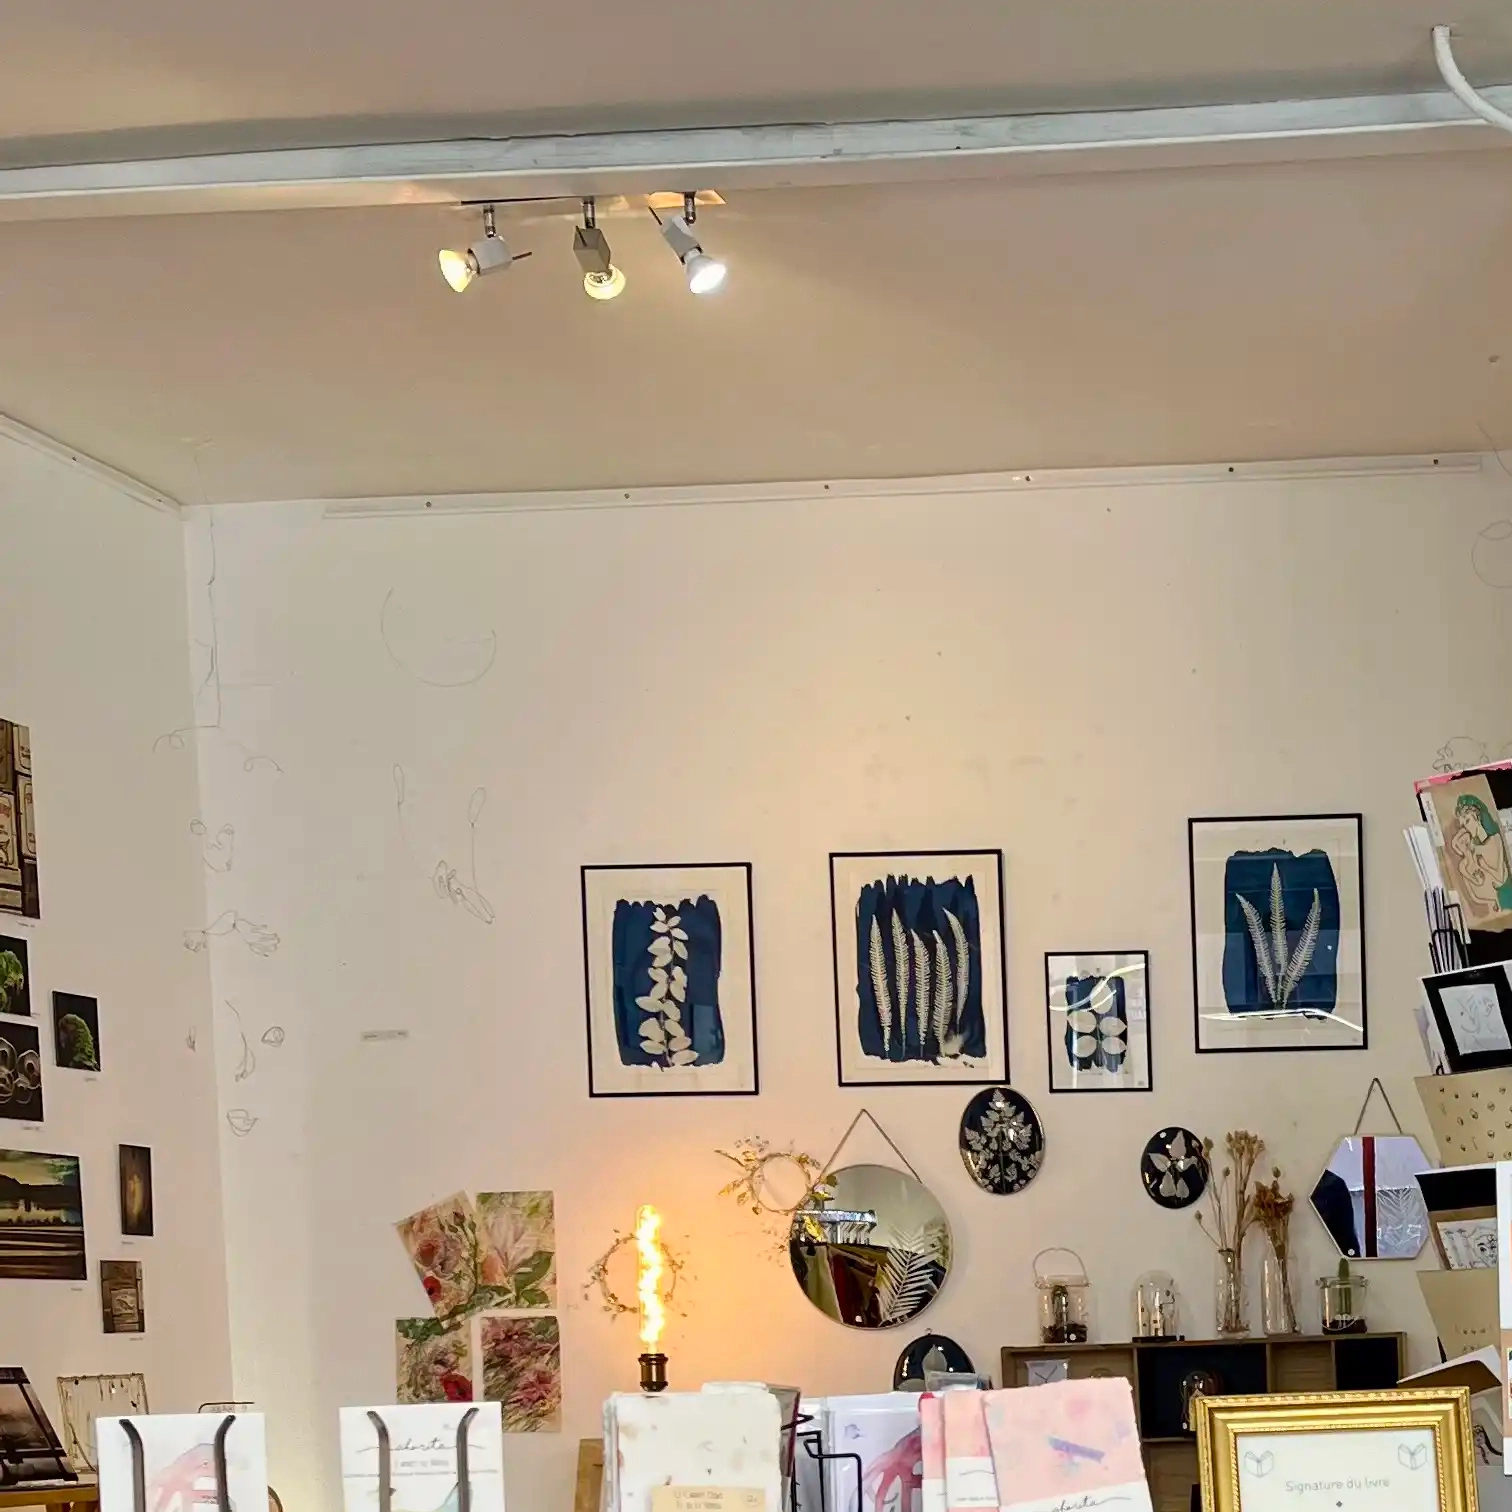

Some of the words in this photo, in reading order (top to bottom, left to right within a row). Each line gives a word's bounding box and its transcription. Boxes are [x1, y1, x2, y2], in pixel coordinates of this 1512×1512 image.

[1285, 1479, 1343, 1495] Signature
[1346, 1477, 1362, 1489] du
[1364, 1475, 1391, 1488] livre
